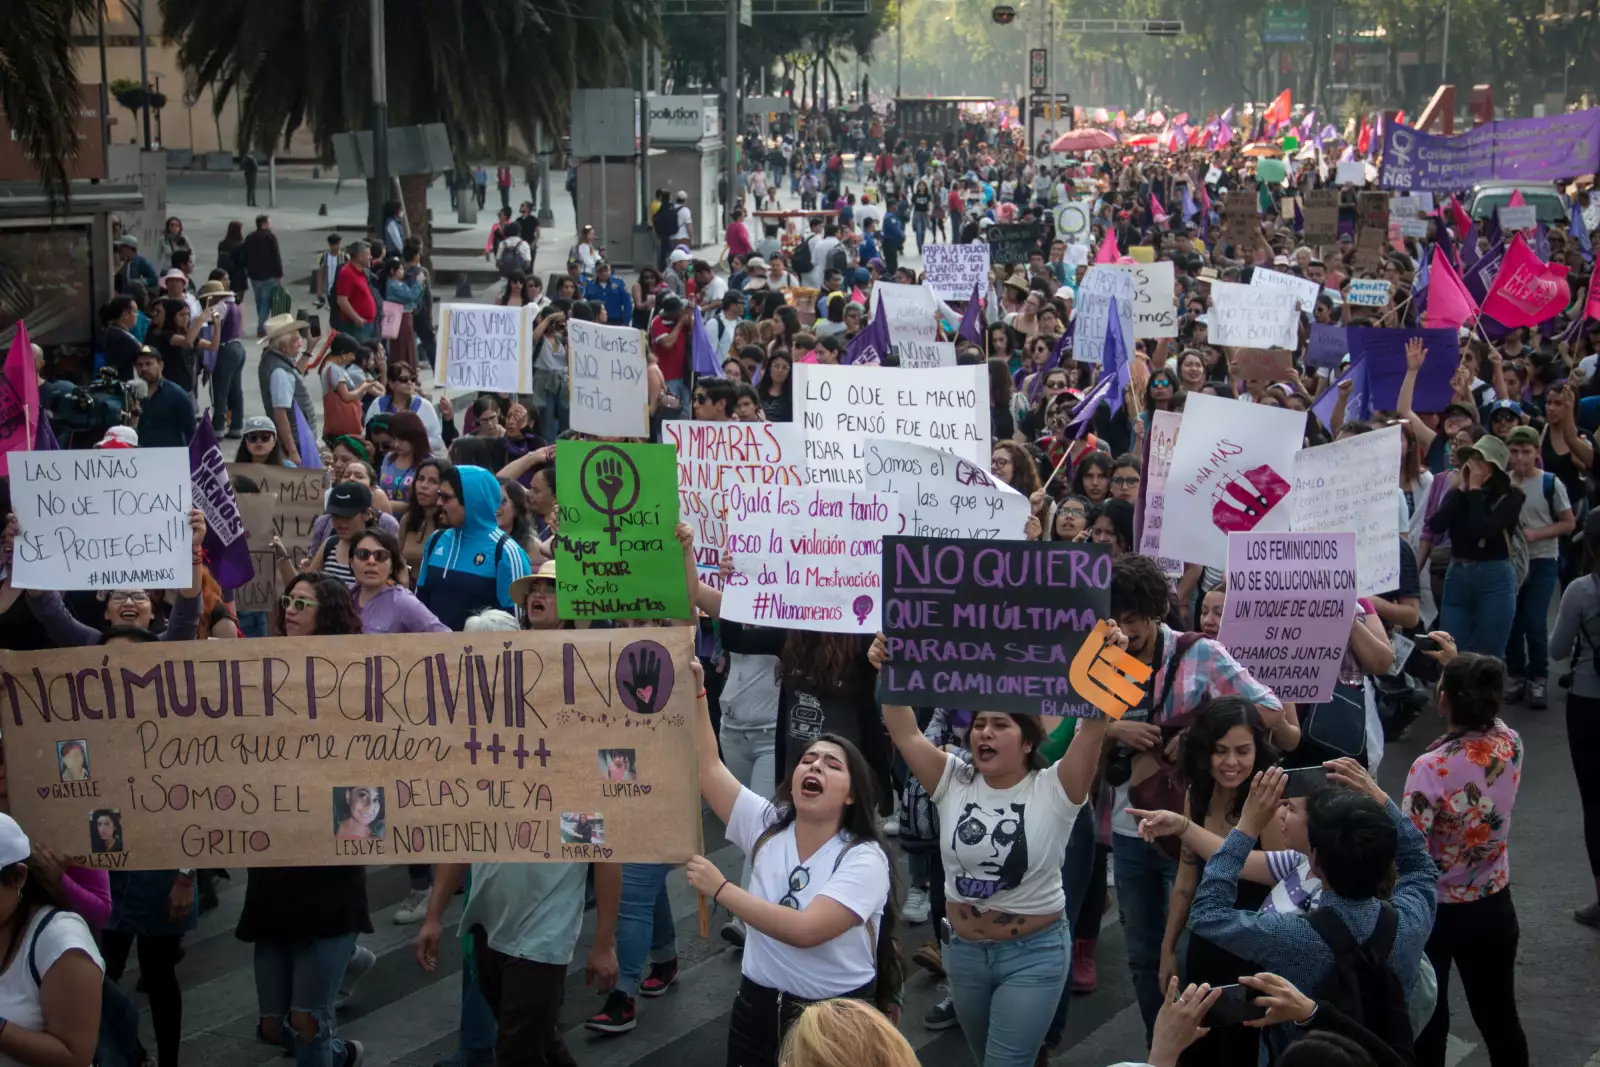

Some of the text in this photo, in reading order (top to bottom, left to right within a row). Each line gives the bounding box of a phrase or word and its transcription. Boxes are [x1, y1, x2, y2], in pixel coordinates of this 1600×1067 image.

[649, 107, 699, 120] pollution
[571, 324, 590, 346] Sin
[450, 362, 499, 387] JUNTAS
[574, 352, 643, 384] NO Hay
[575, 386, 612, 413] Trata
[805, 380, 976, 409] LO QUE EL MACHO
[804, 411, 983, 442] NO PENSÓ FUE QUE AL
[688, 422, 783, 464] MIRARAS
[804, 440, 841, 460] PISAR
[25, 455, 139, 482] LAS NIÑAS
[866, 445, 923, 477] Somos
[930, 453, 945, 477] el
[279, 473, 320, 502] MÁS
[677, 461, 803, 492] ON NUESTROS
[804, 468, 863, 485] SEMILLAS
[37, 493, 65, 518] NO
[678, 489, 709, 519] JOS
[730, 483, 771, 522] Ojalá
[777, 487, 800, 516] les
[808, 489, 844, 519] diera
[848, 491, 889, 523] tanto
[917, 480, 939, 508] las
[949, 493, 977, 516] que
[984, 495, 1005, 520] ya
[557, 506, 581, 524] NO
[769, 528, 783, 555] la
[789, 527, 847, 556] violación
[1246, 540, 1338, 561] LOS FEMINICIDIOS
[87, 567, 175, 586] #NIUNAMENOS
[757, 563, 778, 586] da
[786, 560, 800, 585] la
[895, 543, 1113, 591] NO QUIERO
[1230, 569, 1356, 592] NO SE SOLUCIONAN CON
[885, 597, 1098, 633] QUE MI ÚLTIMA
[1235, 599, 1345, 619] UN TOQUE DE QUEDA
[1265, 626, 1303, 641] SI NO
[886, 637, 1067, 665] PARADA SEA
[1290, 646, 1342, 660] JUNTAS
[887, 666, 1069, 698] LA CAMIONETA
[1257, 665, 1320, 680] MATARAN
[137, 720, 452, 771] Para que me maten
[51, 780, 102, 800] GISELLE
[273, 783, 311, 814] EL
[521, 780, 553, 812] YA
[602, 783, 642, 798] LUPITA
[181, 823, 272, 857] GRITO
[335, 838, 386, 857] LESLYE
[561, 845, 603, 860] MARA
